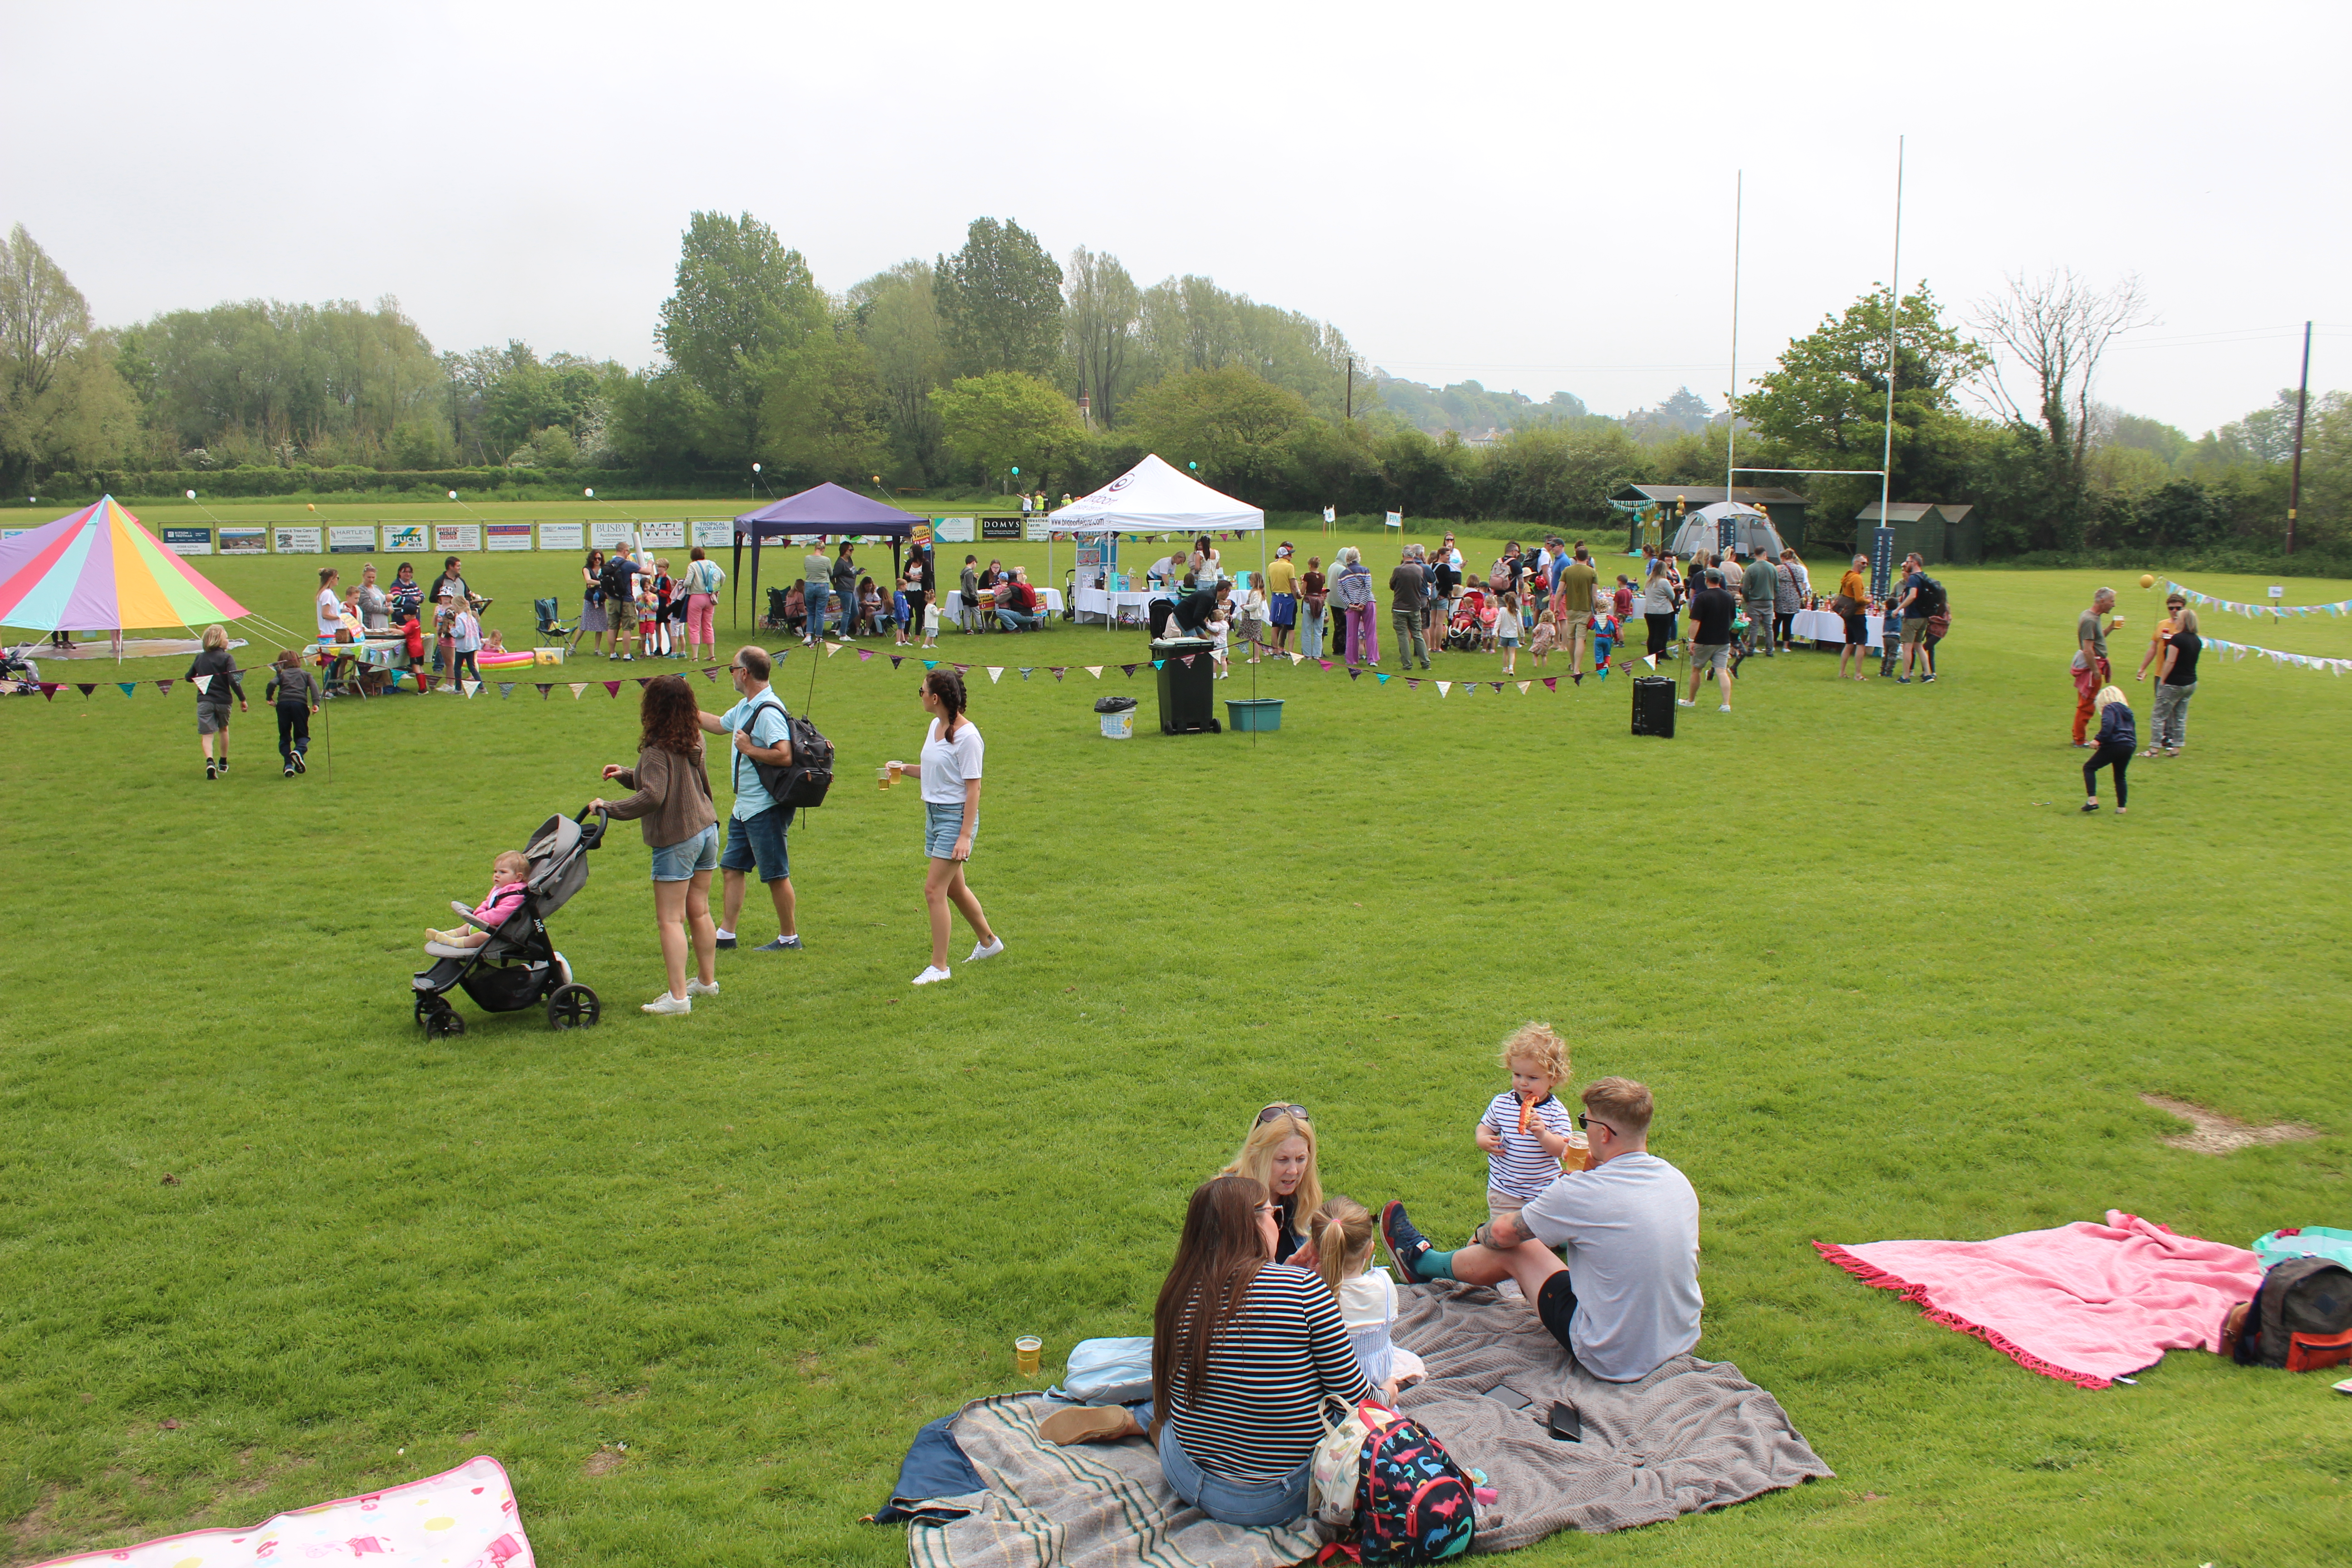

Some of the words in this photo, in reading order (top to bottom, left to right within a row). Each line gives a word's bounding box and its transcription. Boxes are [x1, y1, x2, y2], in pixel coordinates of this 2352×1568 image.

[597, 524, 628, 532] BUSBY
[643, 523, 681, 536] WTL
[392, 534, 422, 543] HUCK
[1886, 536, 1894, 577] BRIDPORT
[534, 918, 544, 933] Joie
